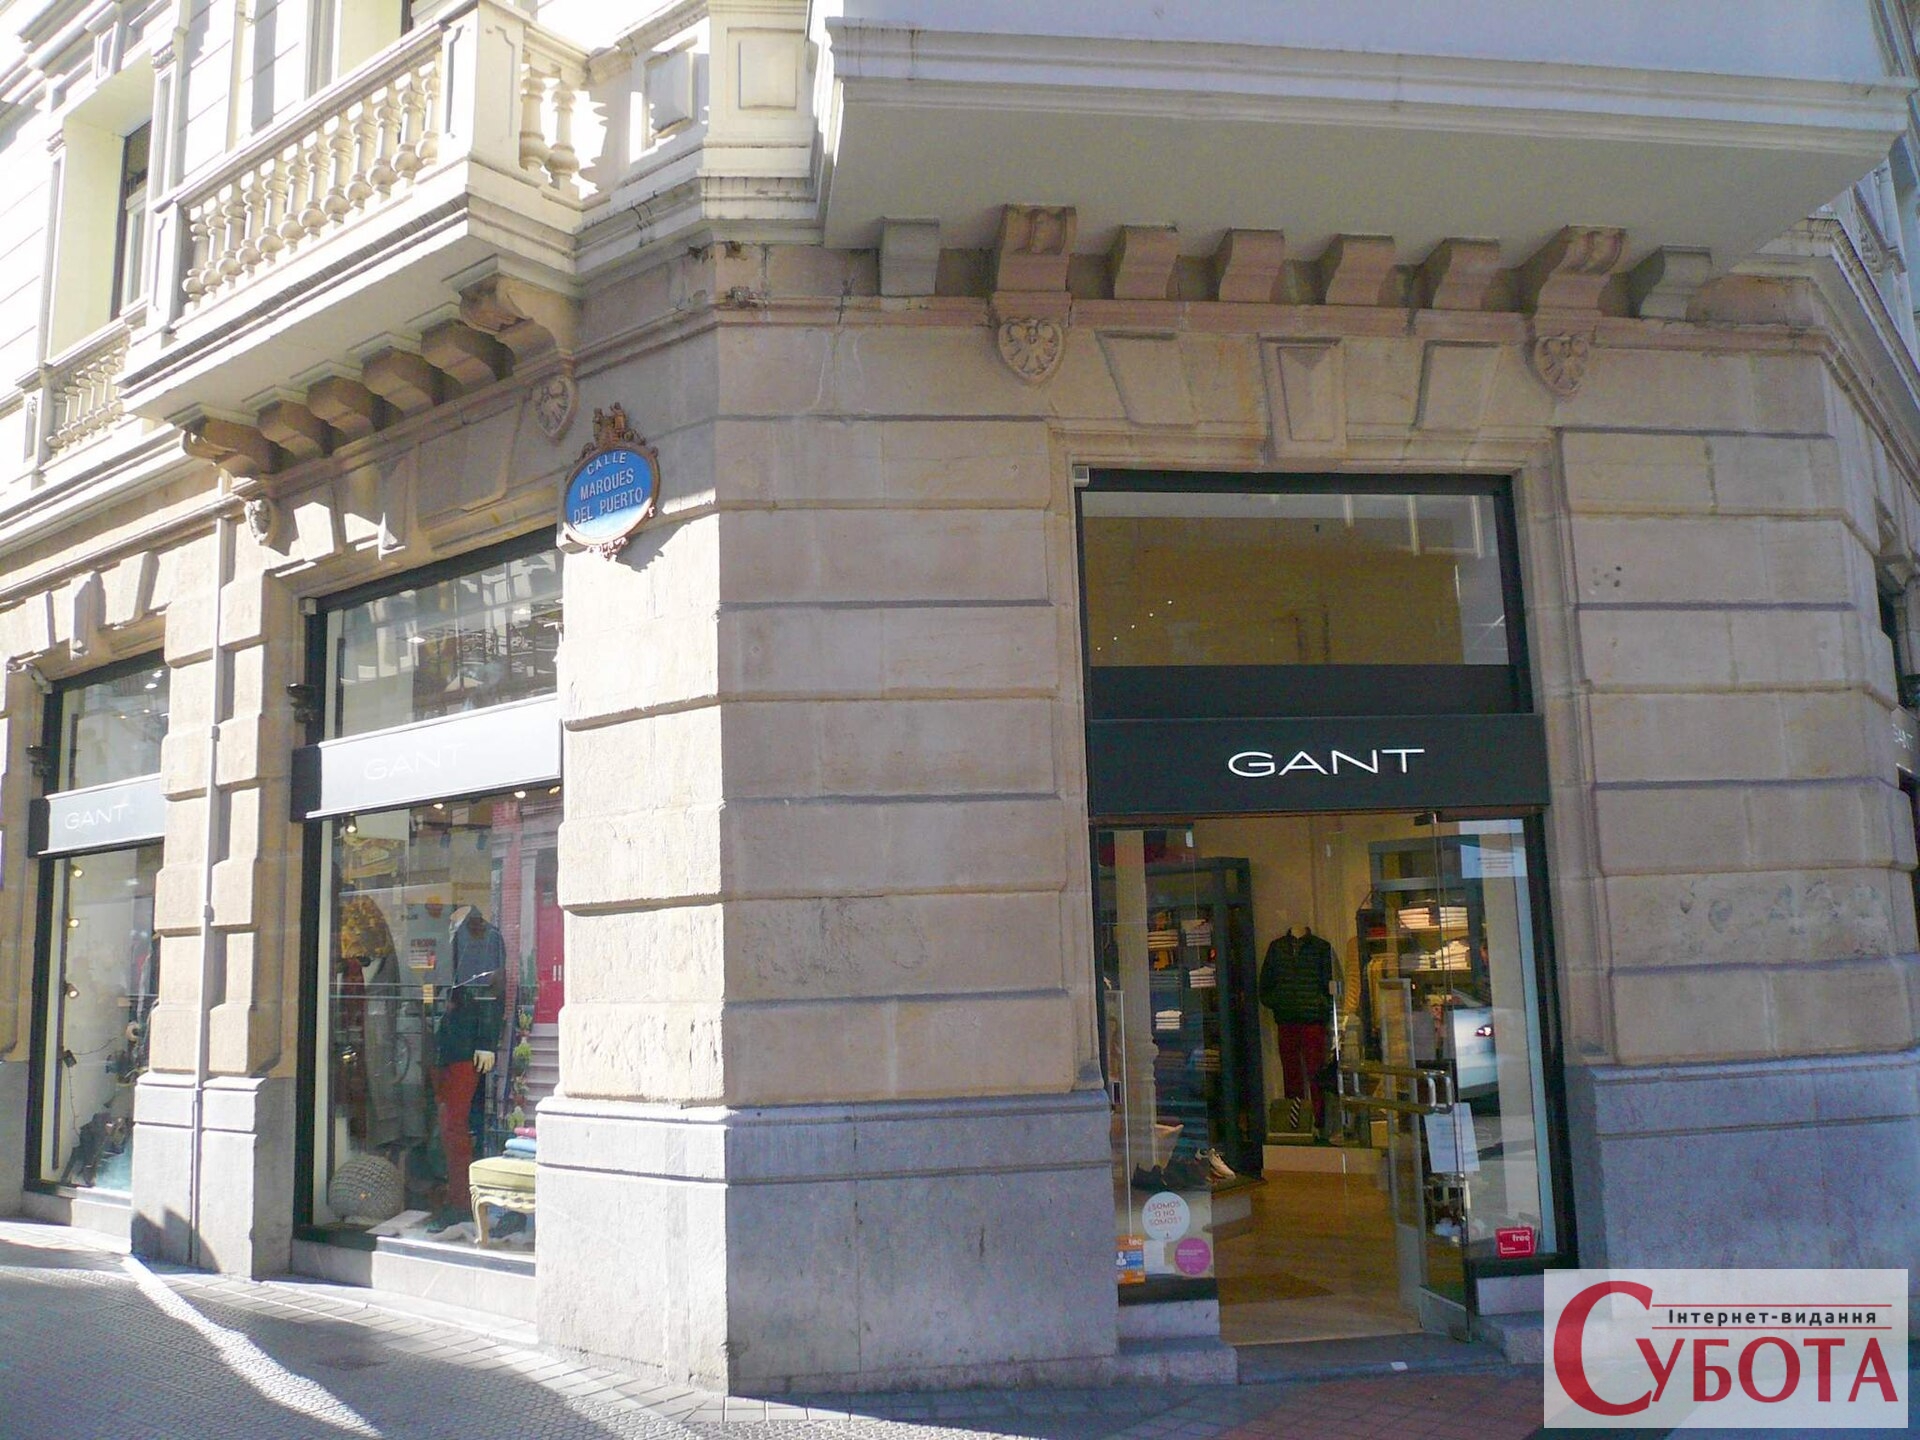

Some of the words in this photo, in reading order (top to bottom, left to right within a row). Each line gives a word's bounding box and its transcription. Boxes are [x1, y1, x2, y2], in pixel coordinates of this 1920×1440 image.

[586, 452, 627, 475] CALLE
[580, 467, 634, 501] MARQUES
[573, 505, 593, 525] DEL
[600, 487, 643, 515] PUERTO
[364, 742, 468, 780] GANT
[1228, 748, 1425, 778] GANT
[65, 803, 129, 830] GANT
[1512, 1234, 1531, 1242] free
